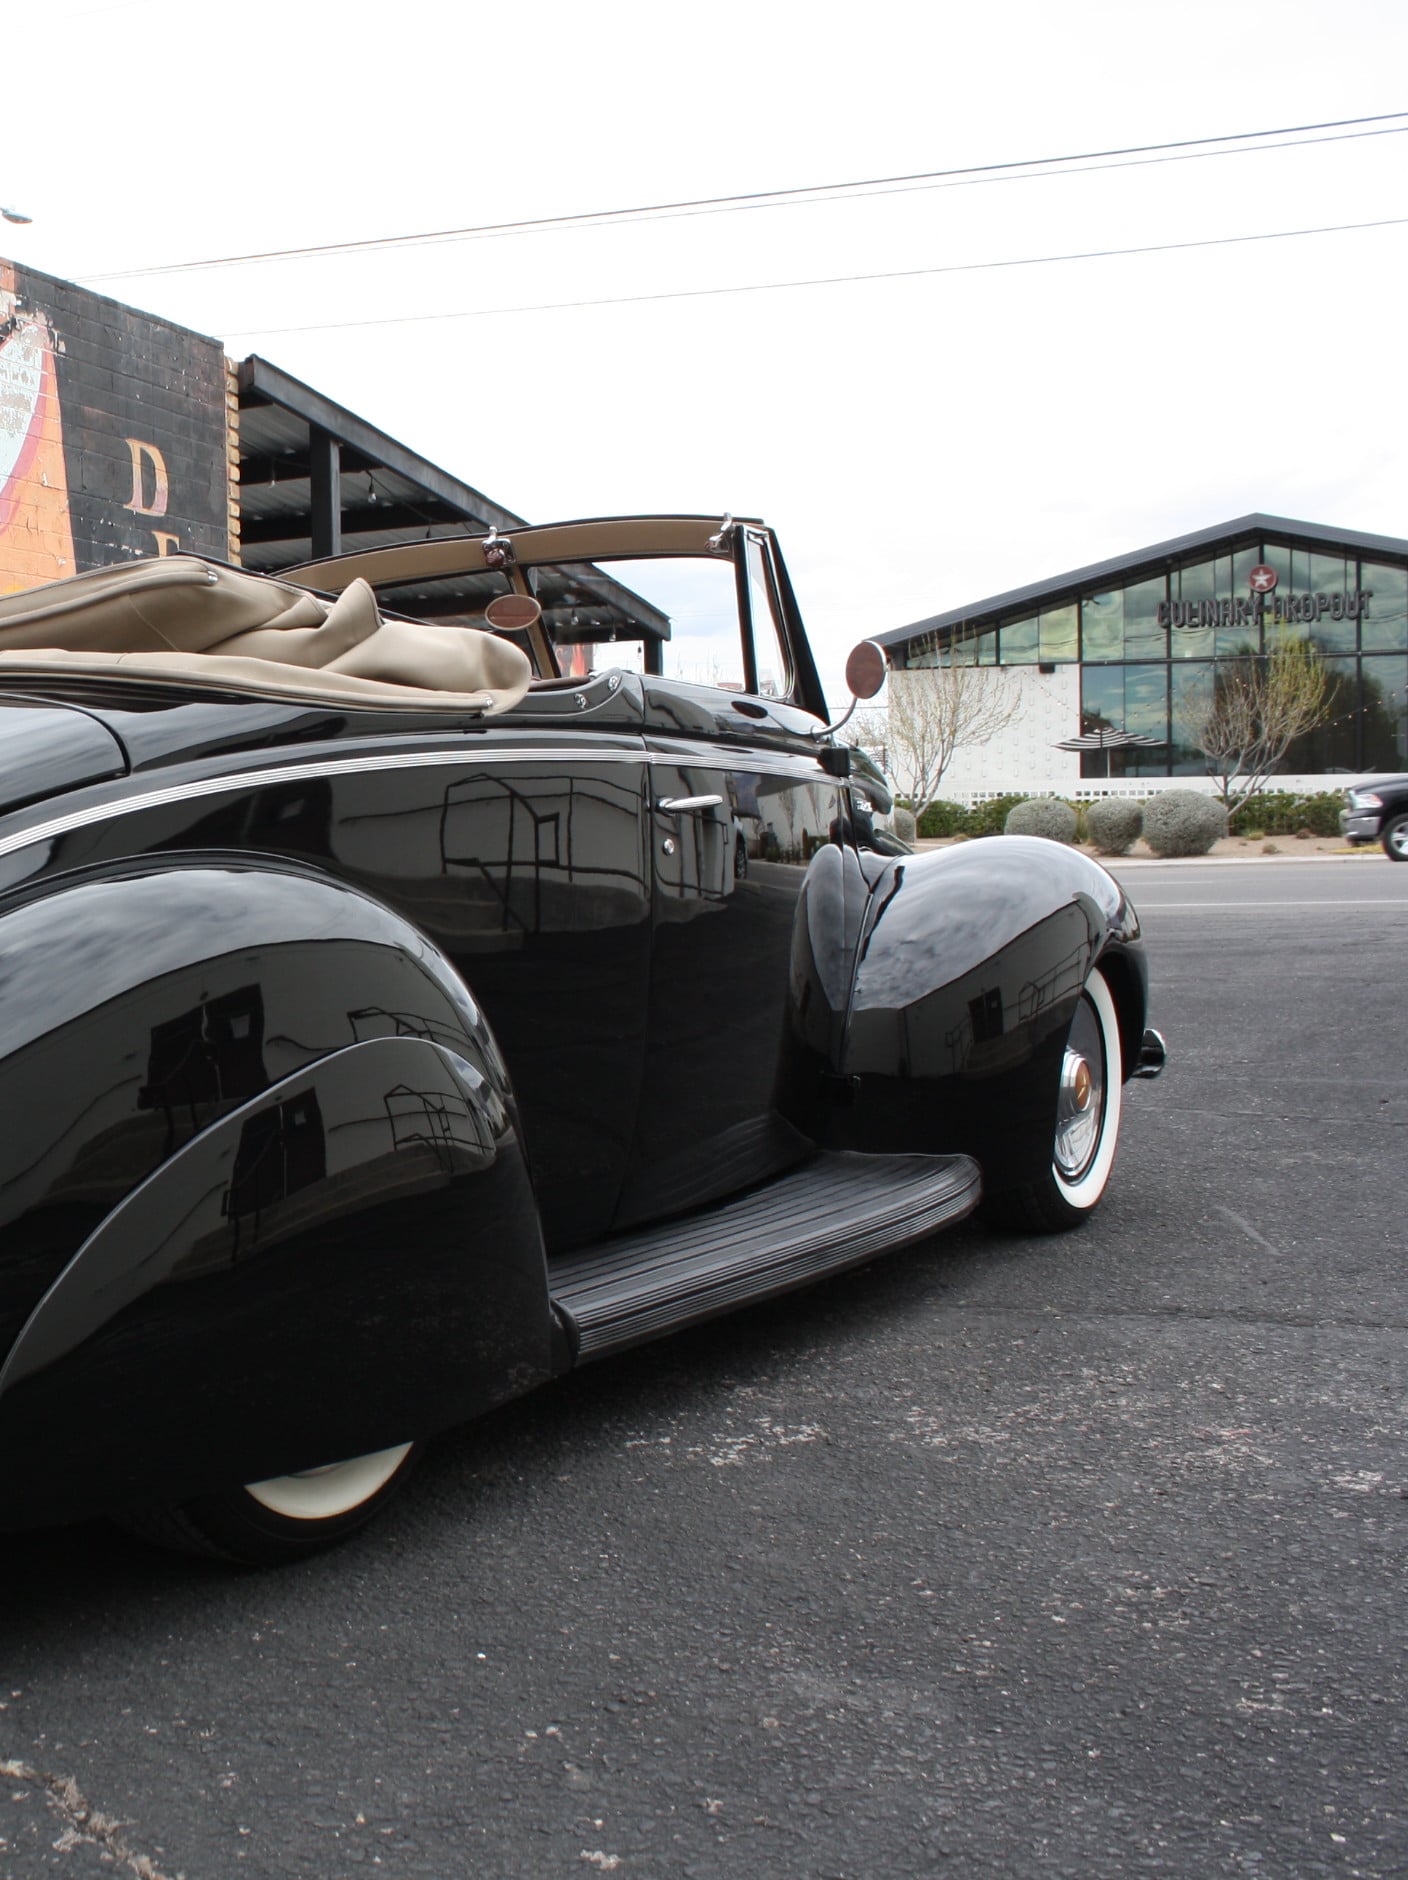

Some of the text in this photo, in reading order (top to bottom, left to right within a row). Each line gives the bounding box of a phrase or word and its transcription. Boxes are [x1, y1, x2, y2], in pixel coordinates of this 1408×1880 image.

[123, 438, 169, 516] D
[1157, 590, 1374, 628] CULINARY DROPOUT
